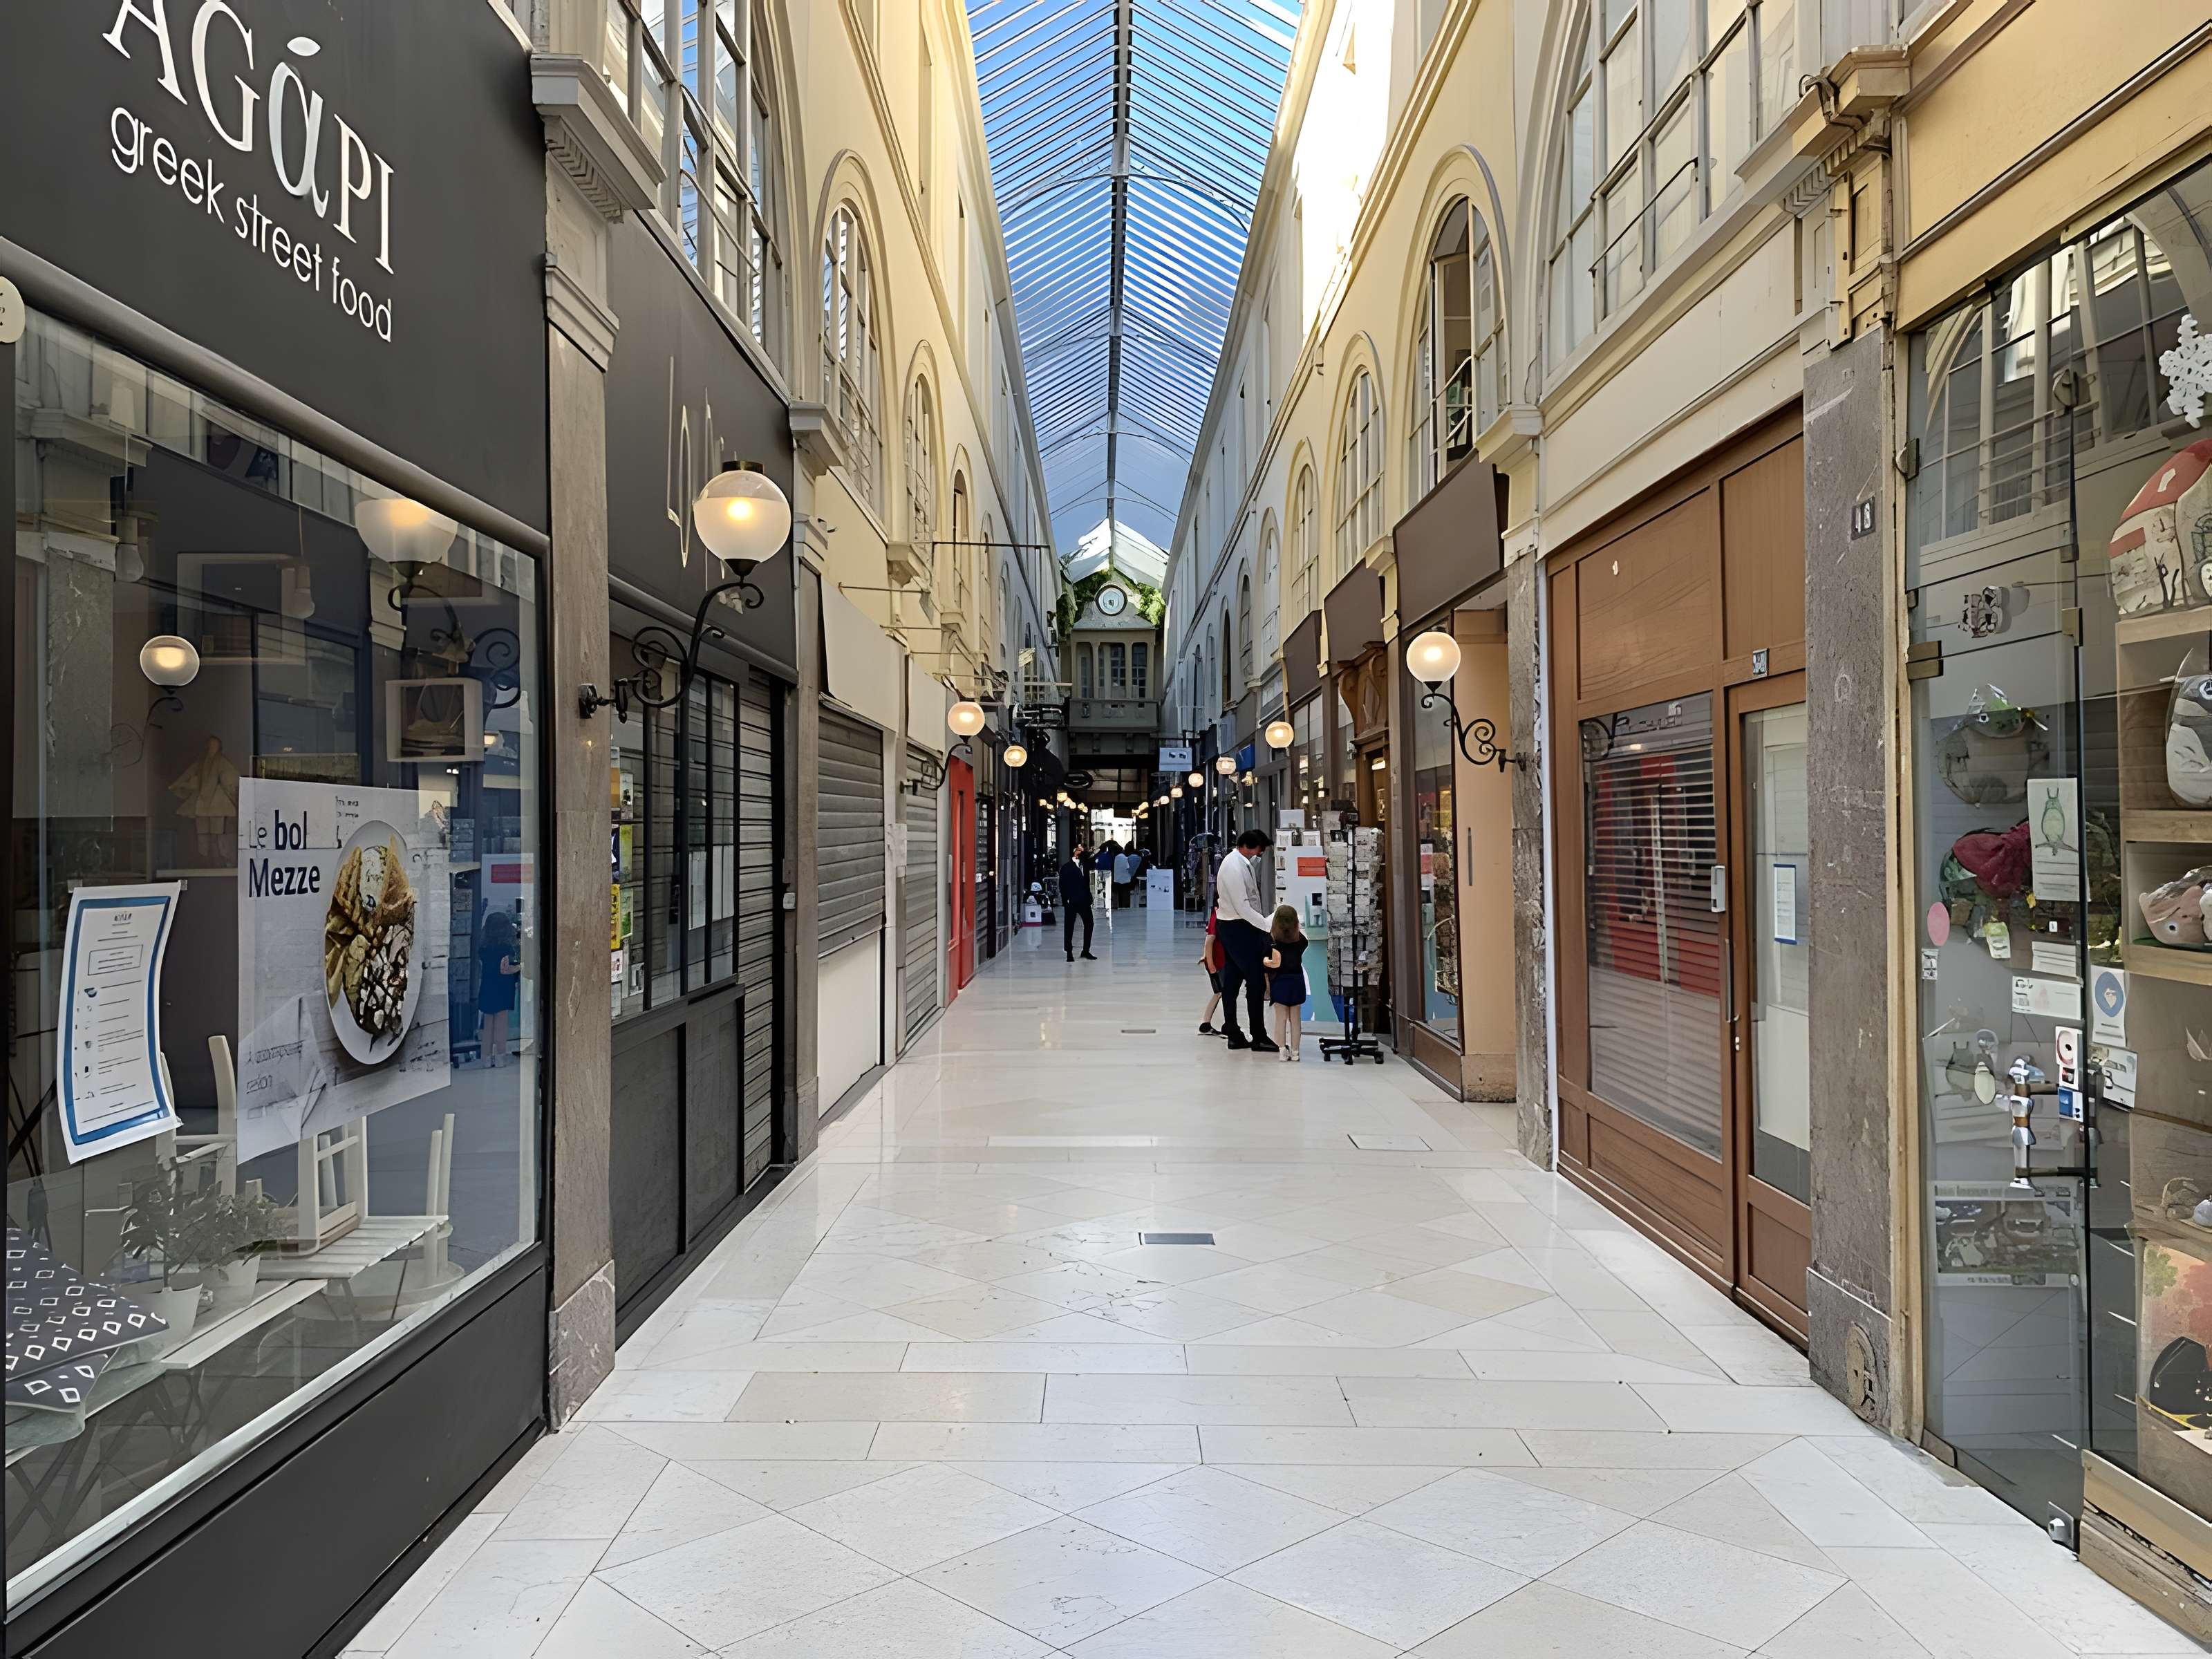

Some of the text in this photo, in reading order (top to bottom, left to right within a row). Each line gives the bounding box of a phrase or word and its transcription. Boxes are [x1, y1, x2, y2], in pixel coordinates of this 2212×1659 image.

[111, 106, 393, 344] greek street food
[274, 809, 308, 850] bol
[248, 857, 321, 898] Mezze
